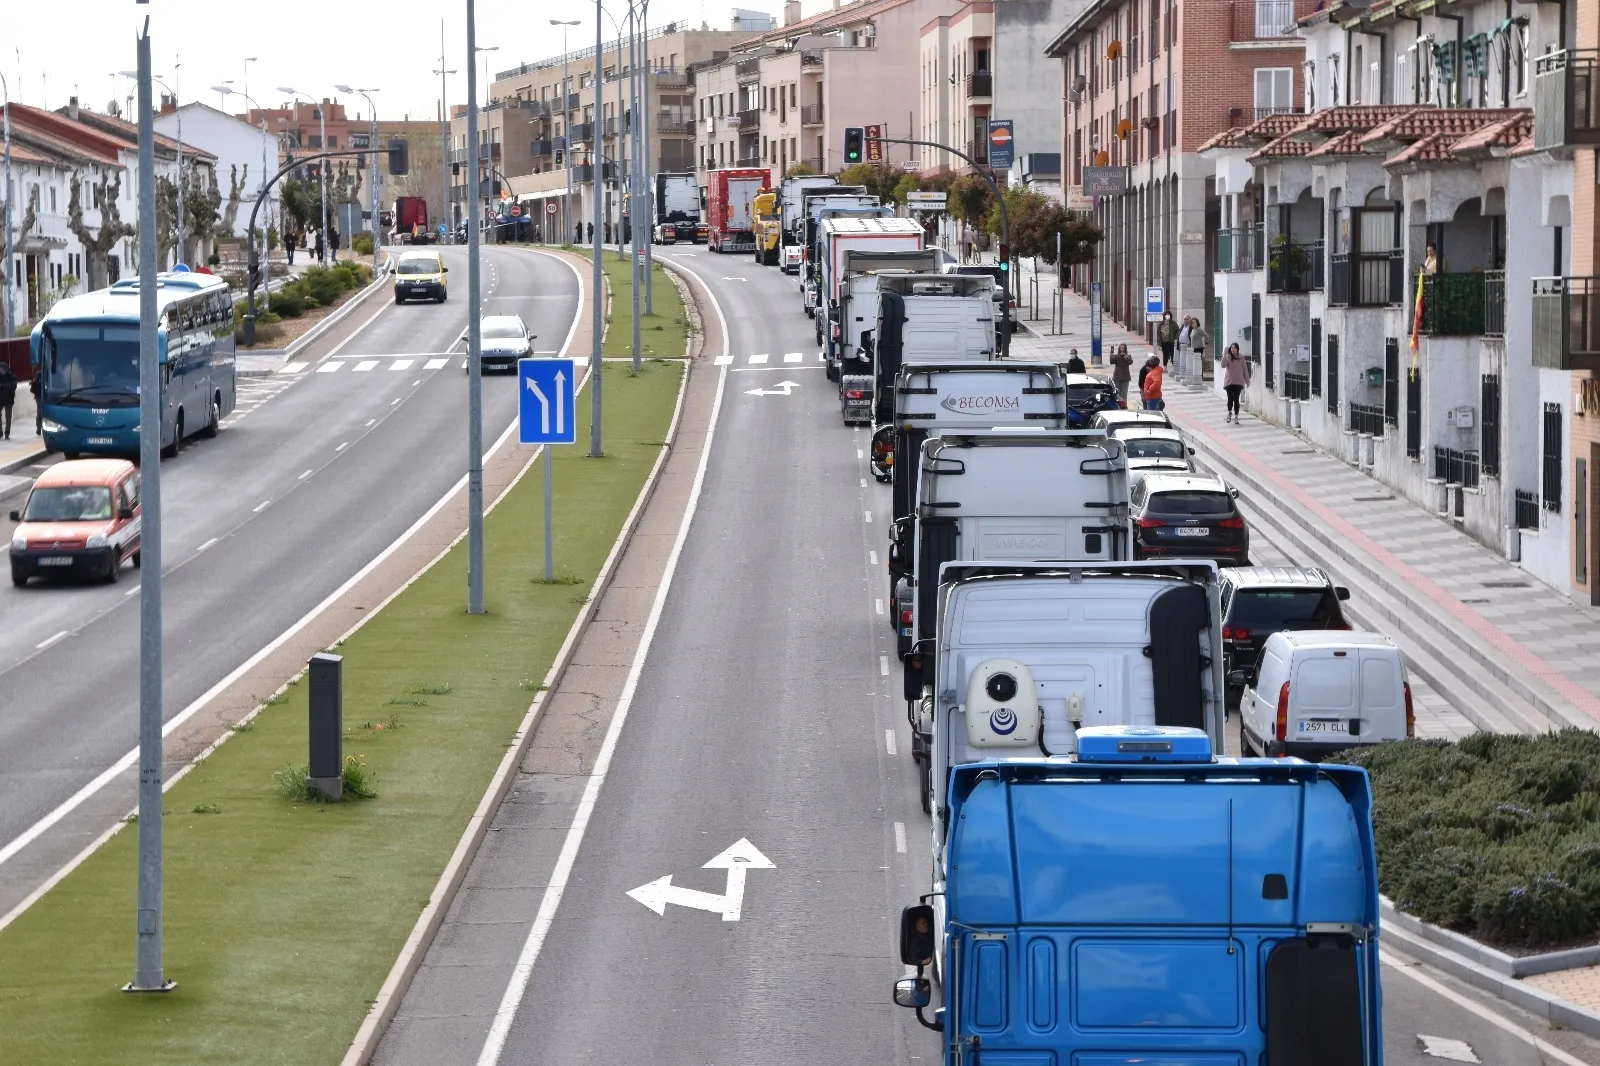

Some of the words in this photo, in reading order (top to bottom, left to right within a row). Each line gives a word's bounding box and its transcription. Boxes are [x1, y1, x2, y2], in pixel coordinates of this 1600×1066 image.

[959, 396, 1020, 408] BECONSA
[996, 536, 1048, 549] IVECO
[1305, 723, 1327, 732] 2571
[1331, 723, 1347, 732] CLL
